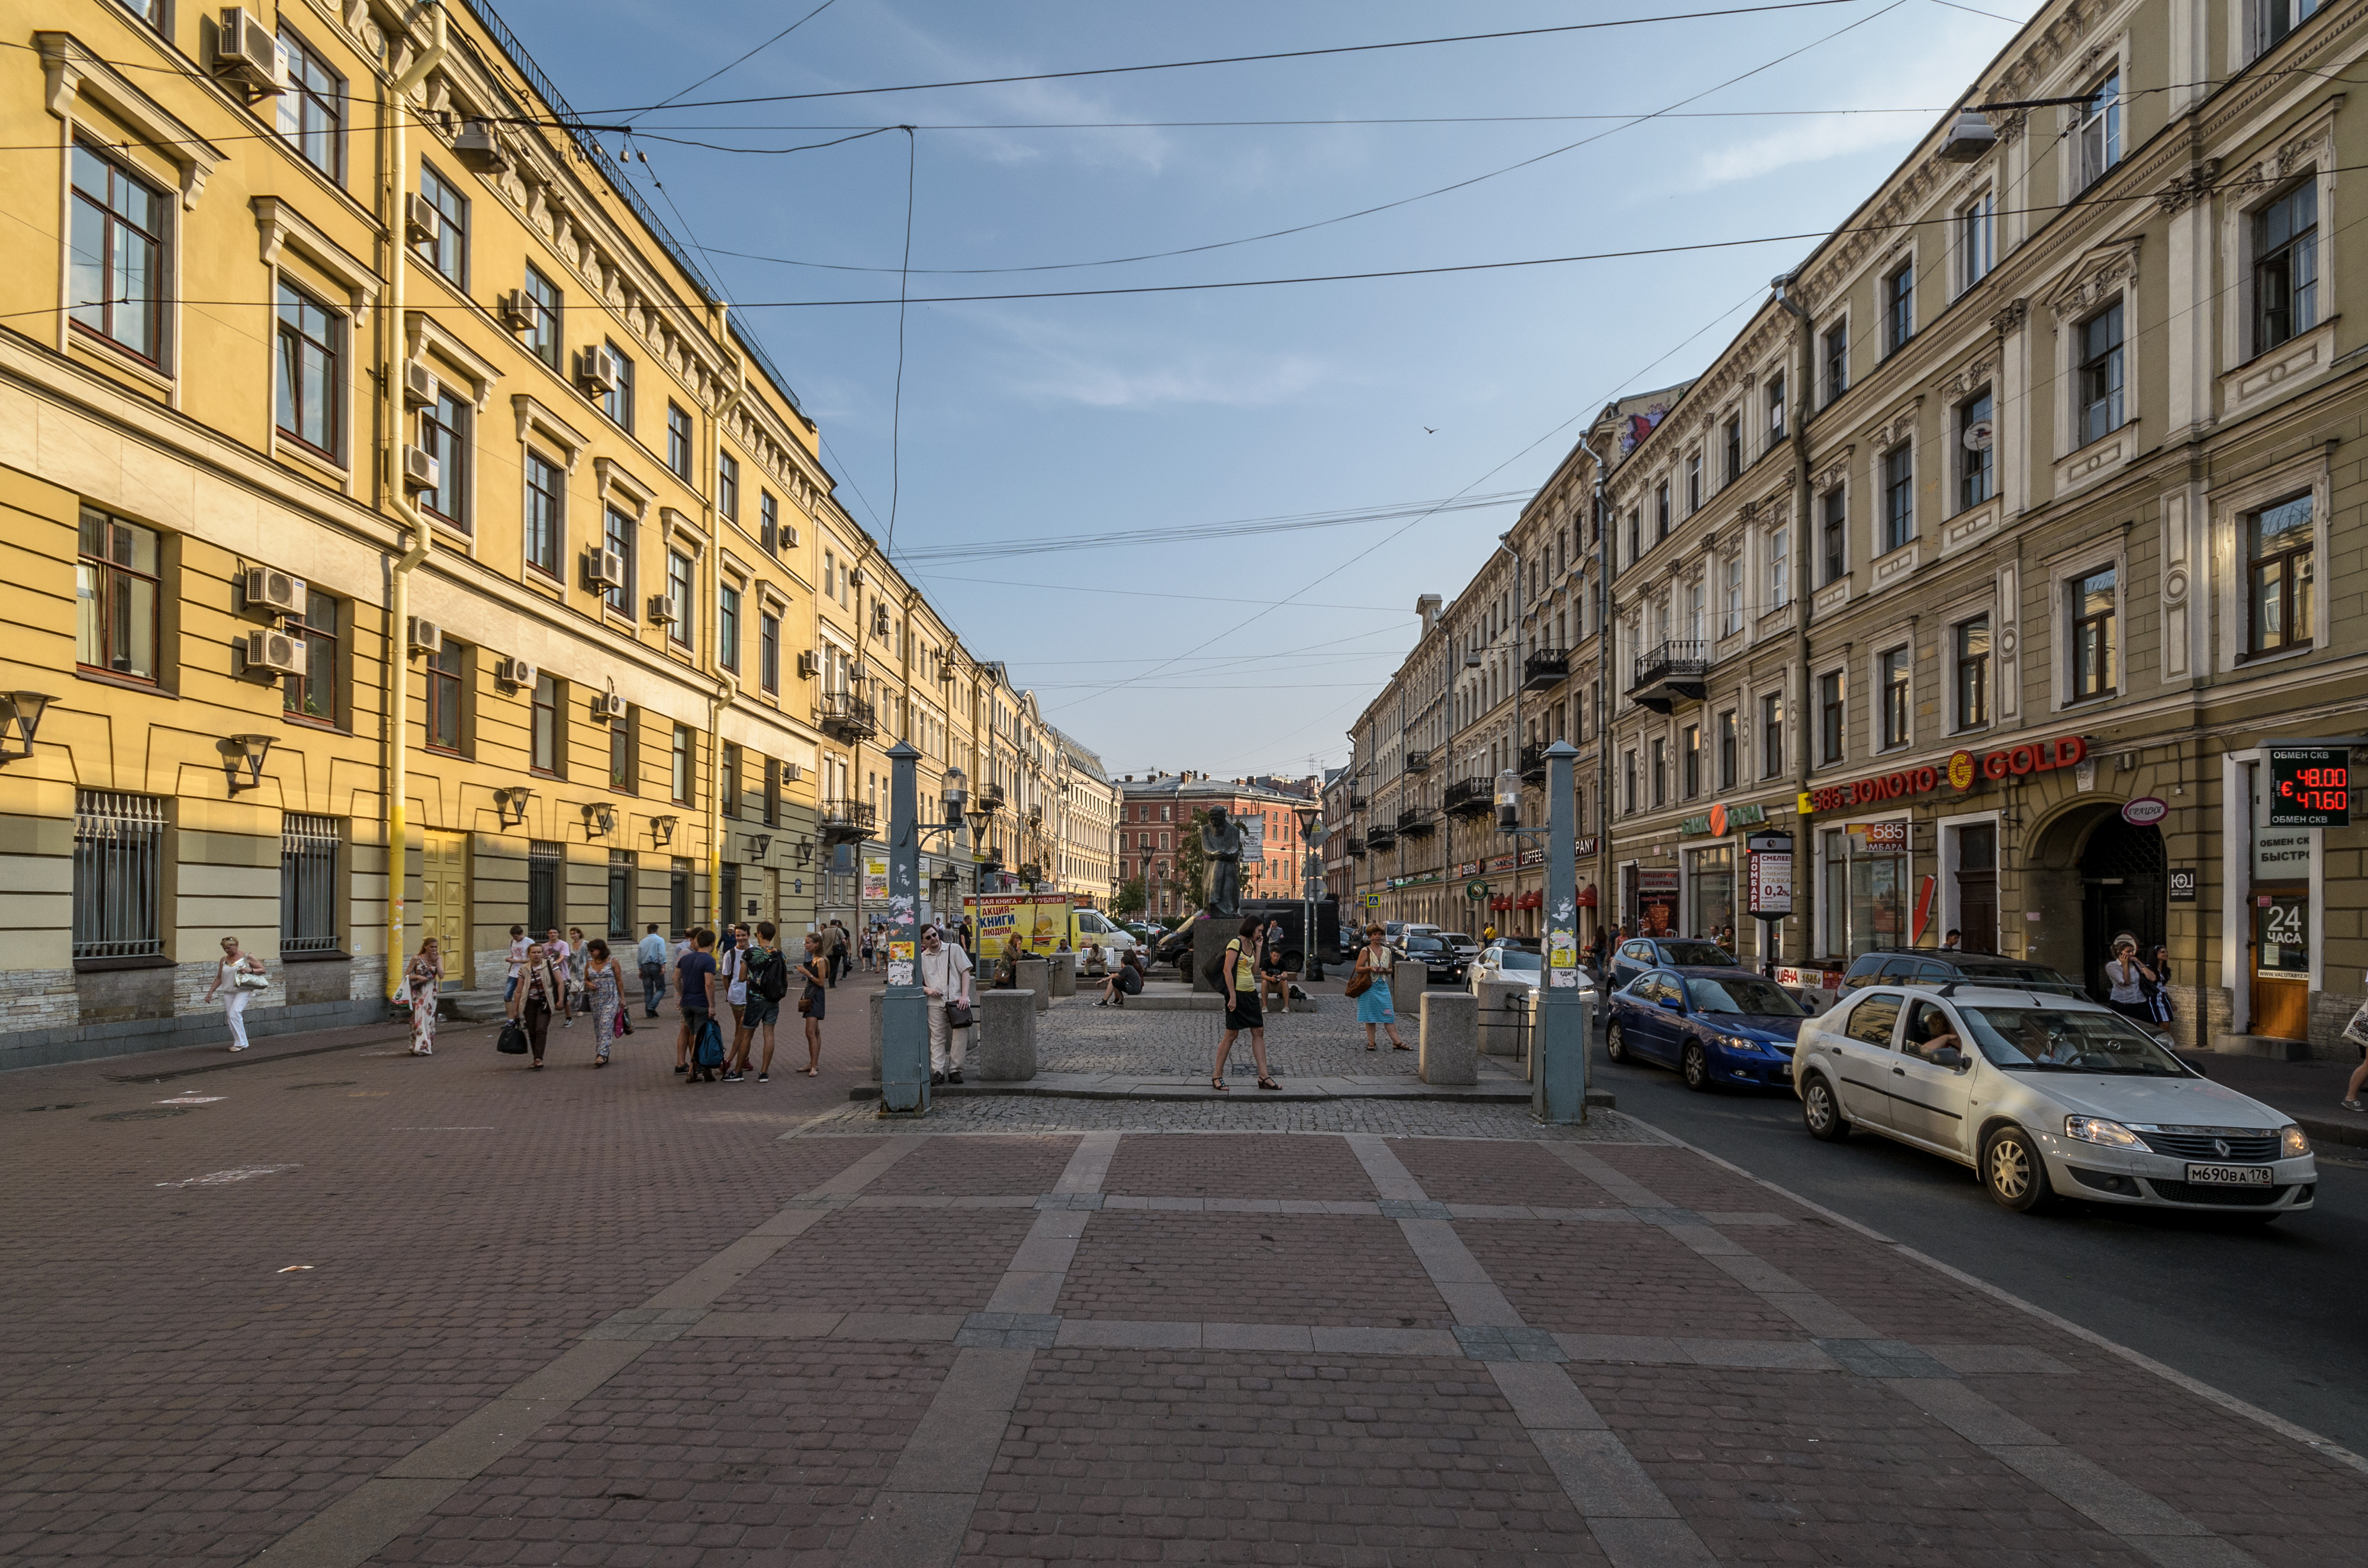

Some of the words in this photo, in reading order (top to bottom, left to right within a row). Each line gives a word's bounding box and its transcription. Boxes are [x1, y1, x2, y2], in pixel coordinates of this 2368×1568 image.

[1984, 736, 2087, 780] GOLD
[2297, 768, 2346, 787] 48.00
[1813, 785, 1845, 812] 585
[1849, 767, 1939, 806] ЗОЛОТО
[2297, 791, 2346, 810] 47.60
[2128, 806, 2163, 816] ГРАЦИЯ
[1682, 813, 1711, 835] БАНК
[1728, 804, 1765, 827] ЮГРА
[1873, 823, 1904, 839] 585
[1575, 838, 1594, 855] PANY
[1867, 843, 1903, 851] МБАРД
[2260, 838, 2293, 847] ОБМЕН
[2297, 836, 2309, 845] СК
[1521, 848, 1545, 865] COFFEE
[1765, 886, 1790, 897] 0,2%
[980, 914, 1015, 928] КНИГИ
[2268, 906, 2302, 931] 24
[983, 926, 1012, 936] ЛЮДЯМ
[2267, 932, 2303, 944] ЧАСА
[1777, 969, 1798, 984] ЦЕНА
[2258, 971, 2308, 980] WWW.VALUTA812.R
[2192, 1167, 2247, 1183] М690ВА
[2249, 1169, 2269, 1180] 178
